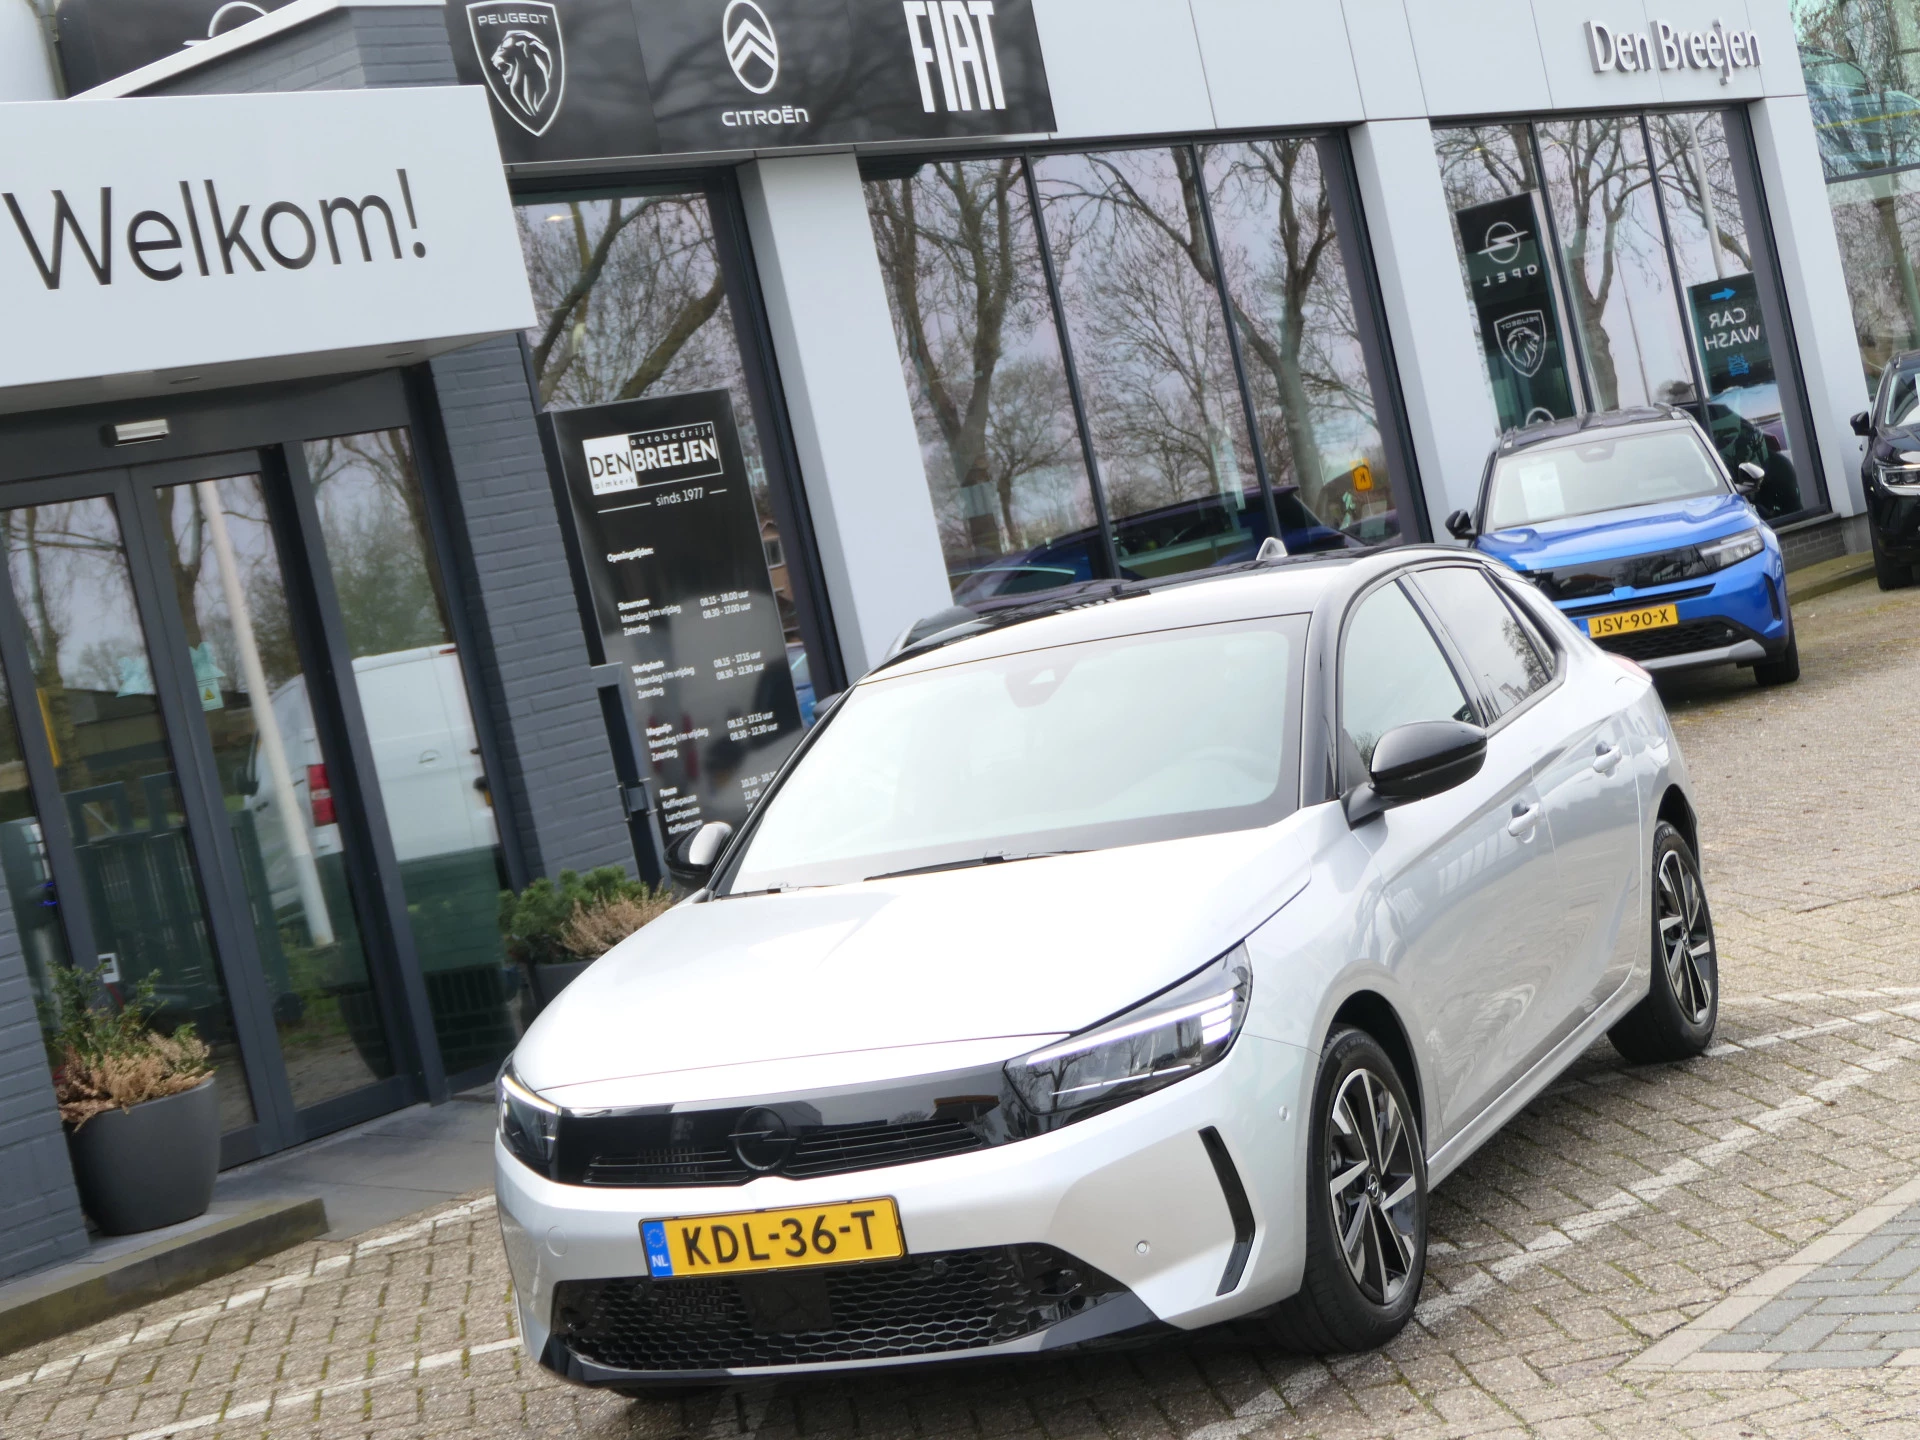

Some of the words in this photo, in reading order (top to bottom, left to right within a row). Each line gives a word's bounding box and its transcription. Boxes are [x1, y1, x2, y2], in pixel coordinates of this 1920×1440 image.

[477, 12, 548, 26] PEUGEOT
[903, 0, 1006, 113] FIAT
[1584, 20, 1653, 73] Den
[1651, 16, 1763, 86] Breejen
[2, 168, 427, 290] Welkom!
[630, 425, 712, 446] autobedrijf
[589, 451, 633, 478] DEN
[632, 437, 718, 472] BREEJEN
[594, 476, 635, 490] almkerk
[655, 491, 681, 507] sinds
[681, 486, 704, 503] 1977
[1595, 608, 1669, 634] JSV-90-X
[681, 1209, 875, 1266] KDL-36-T
[651, 1254, 669, 1267] NL
